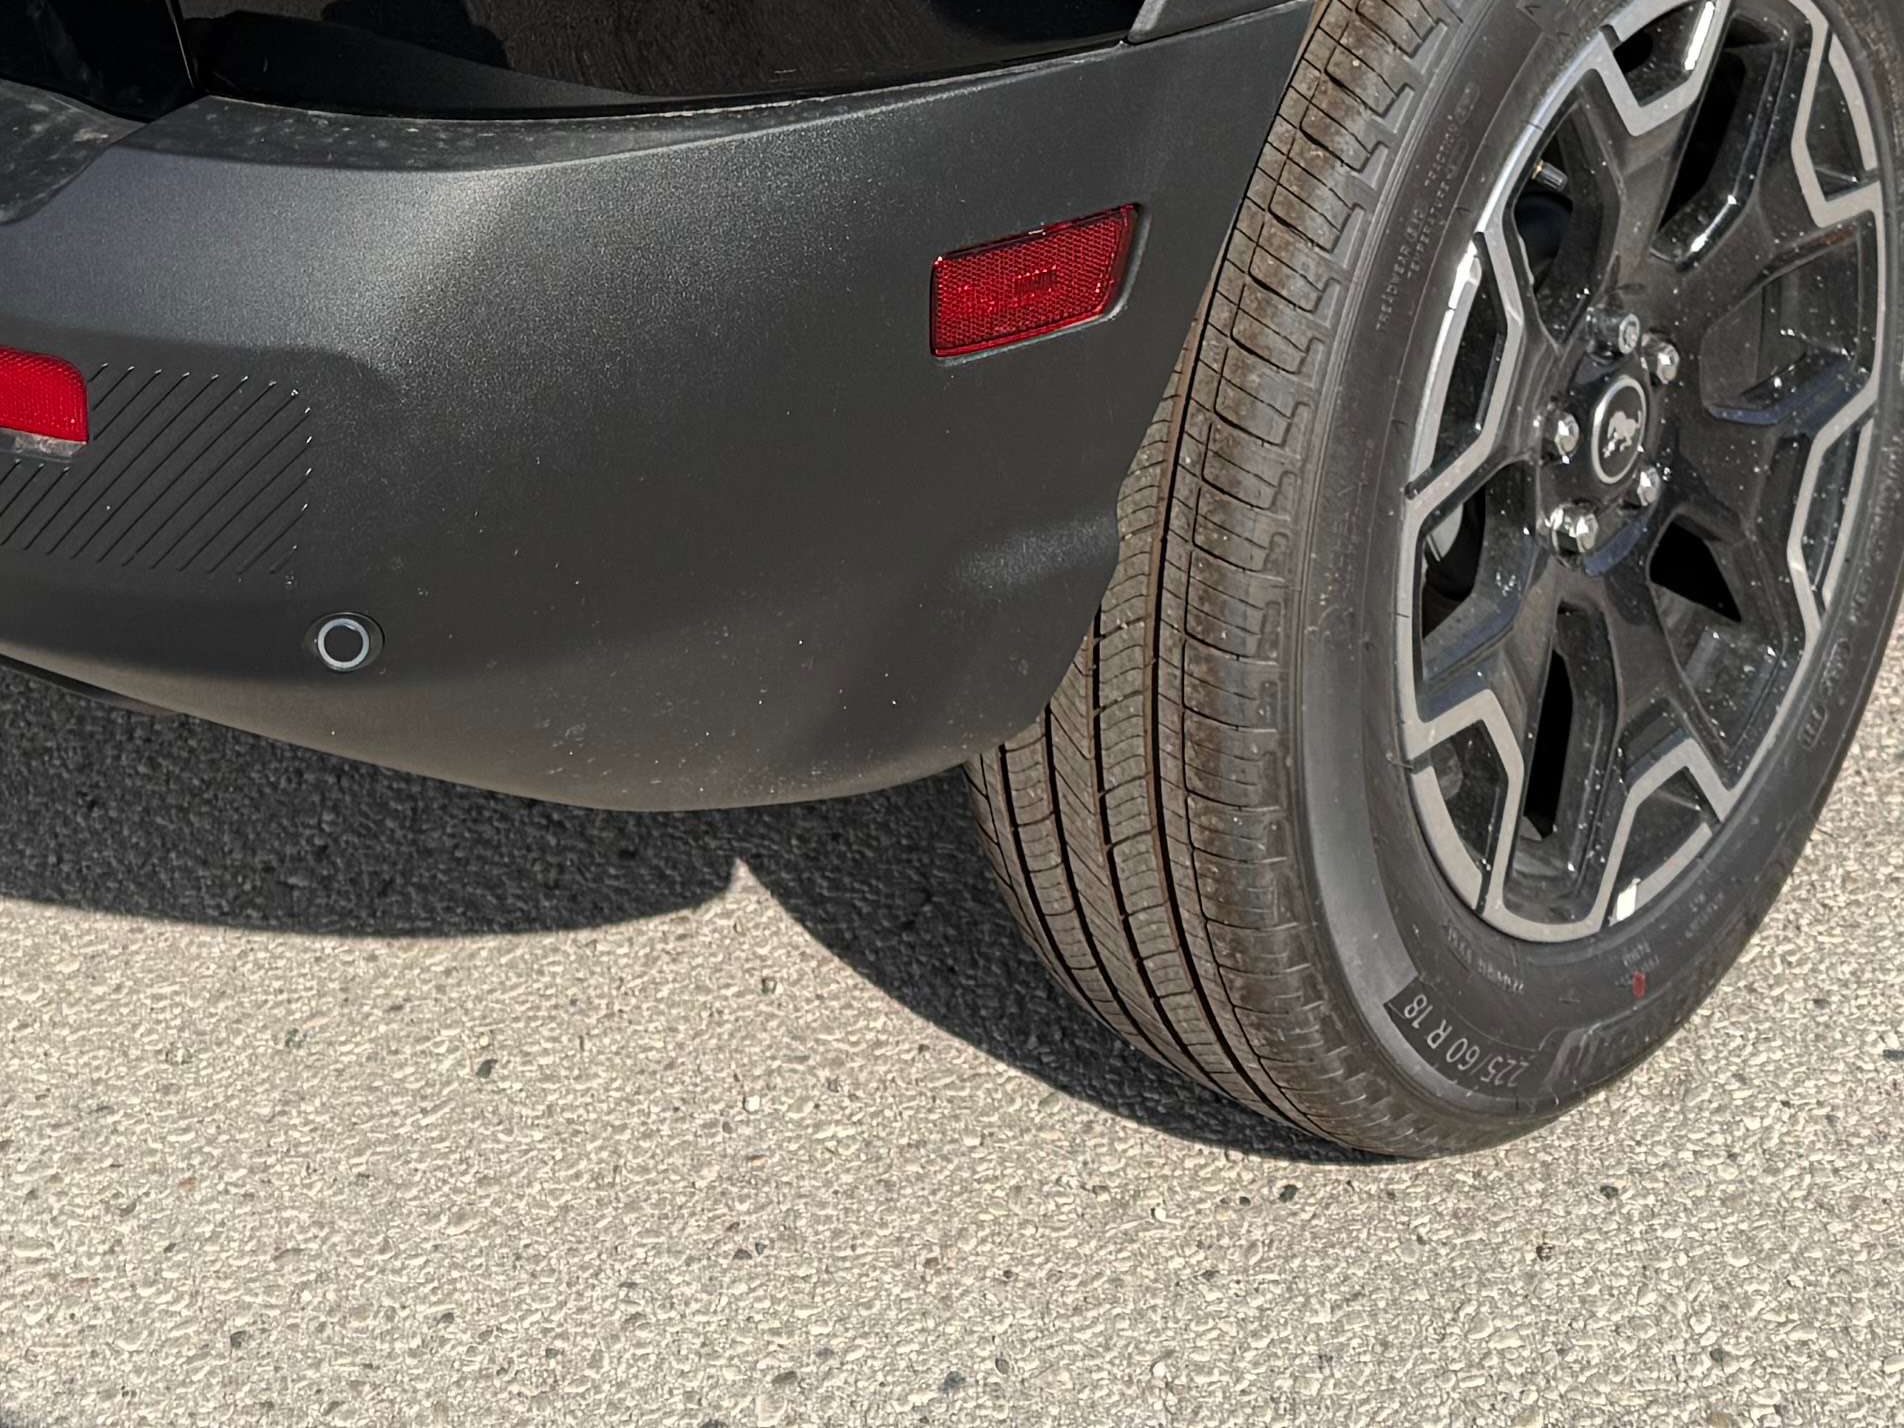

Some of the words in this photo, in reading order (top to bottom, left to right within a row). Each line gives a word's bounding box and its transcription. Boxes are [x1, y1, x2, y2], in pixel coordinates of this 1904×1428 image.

[1403, 993, 1434, 1028] 18
[1425, 1018, 1452, 1048] R
[1447, 1036, 1531, 1088] 225/60
